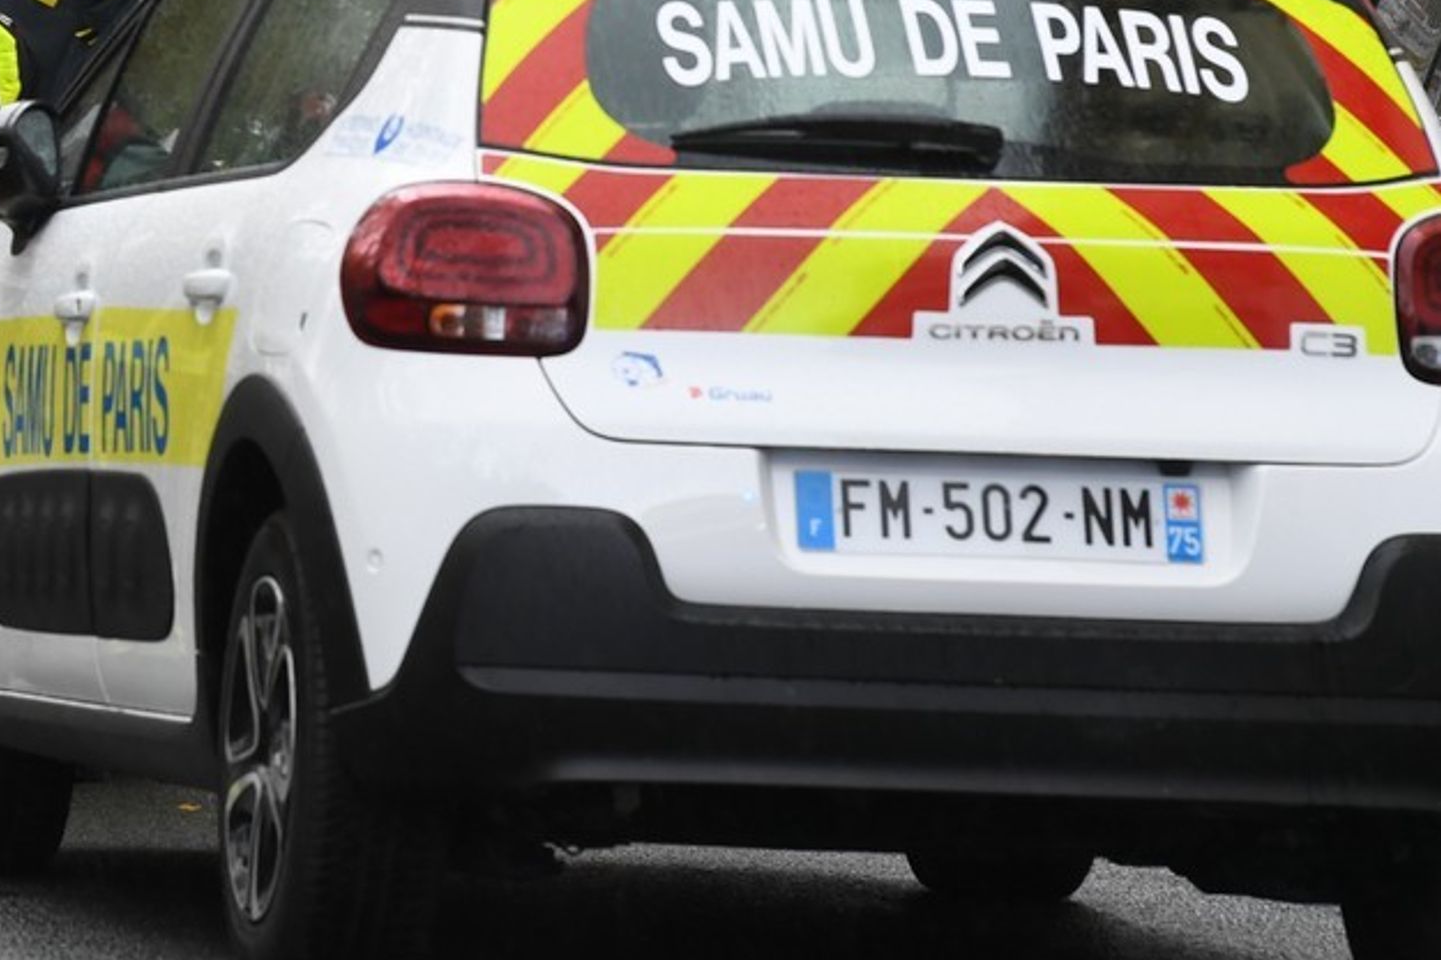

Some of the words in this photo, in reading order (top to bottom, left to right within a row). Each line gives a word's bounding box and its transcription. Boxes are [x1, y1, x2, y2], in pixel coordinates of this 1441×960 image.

[1029, 1, 1249, 103] PARIS
[928, 319, 1081, 342] CITROËN
[1300, 331, 1358, 358] C3
[3, 344, 56, 458] SAMU
[64, 343, 91, 454] DE
[102, 336, 170, 455] PARIS
[840, 478, 1154, 548] FM-502-NM
[1169, 525, 1201, 556] 75
